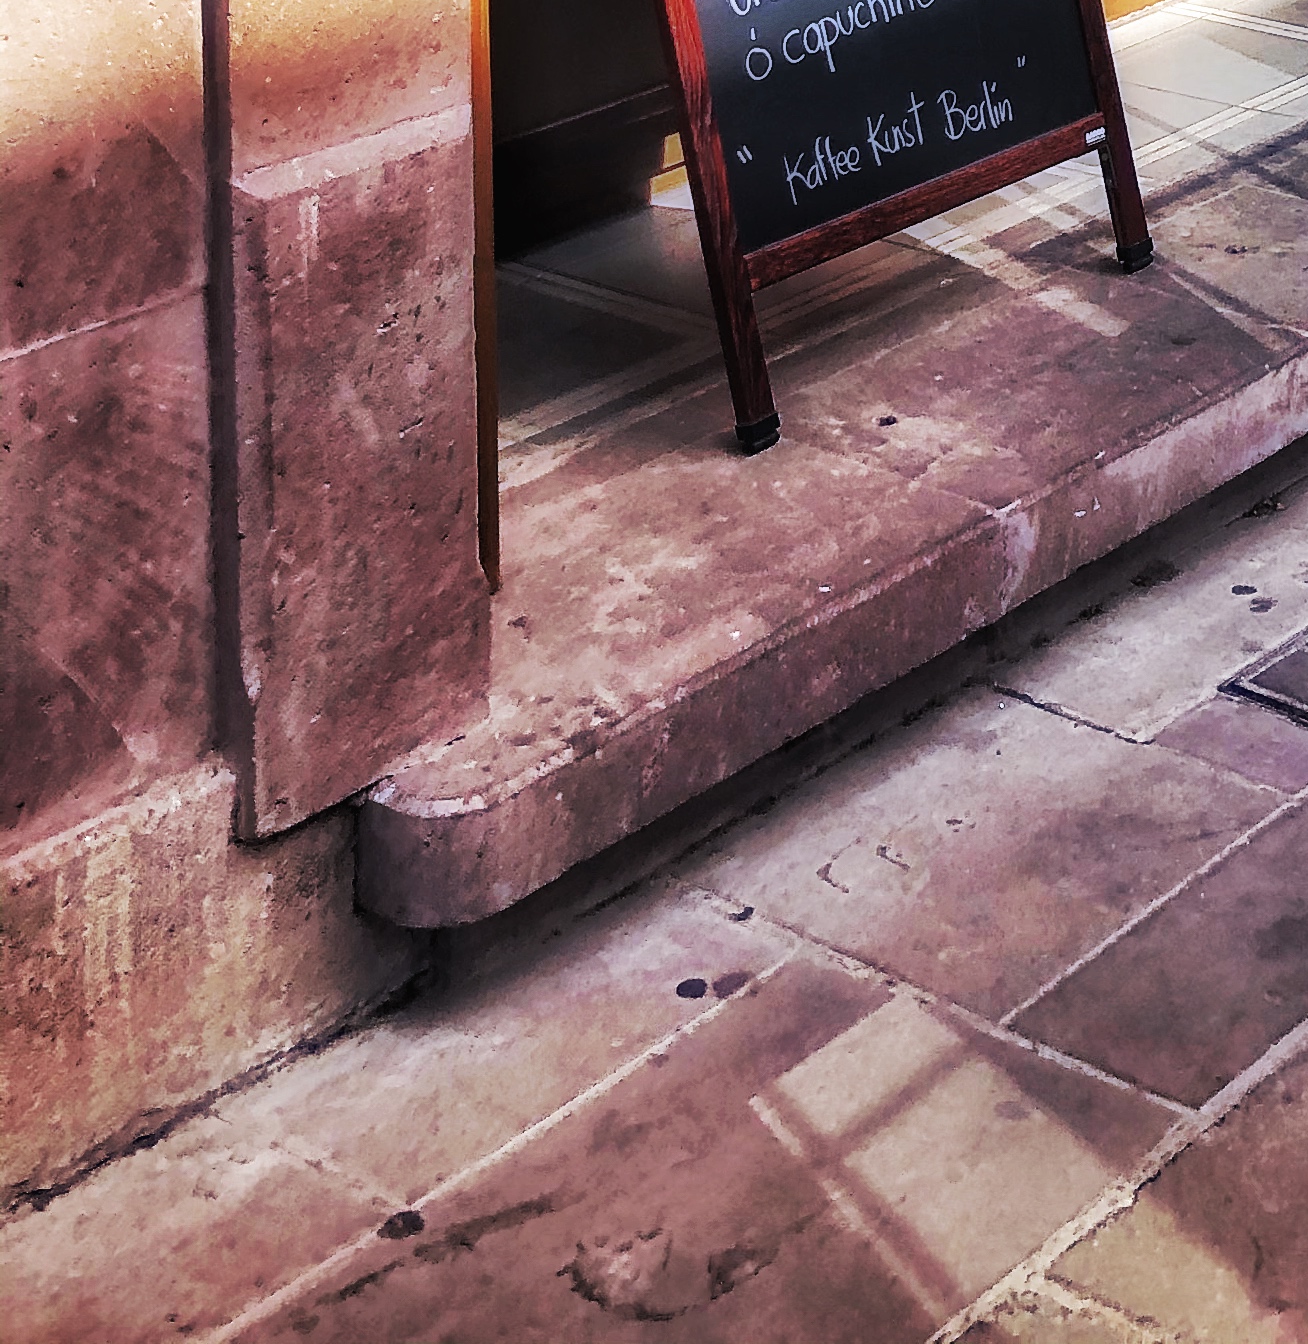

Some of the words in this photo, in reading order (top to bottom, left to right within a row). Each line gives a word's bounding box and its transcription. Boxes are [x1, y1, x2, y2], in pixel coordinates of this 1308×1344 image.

[744, 27, 773, 82] ó
[783, 140, 863, 206] Kaffee
[866, 90, 926, 168] Kunst
